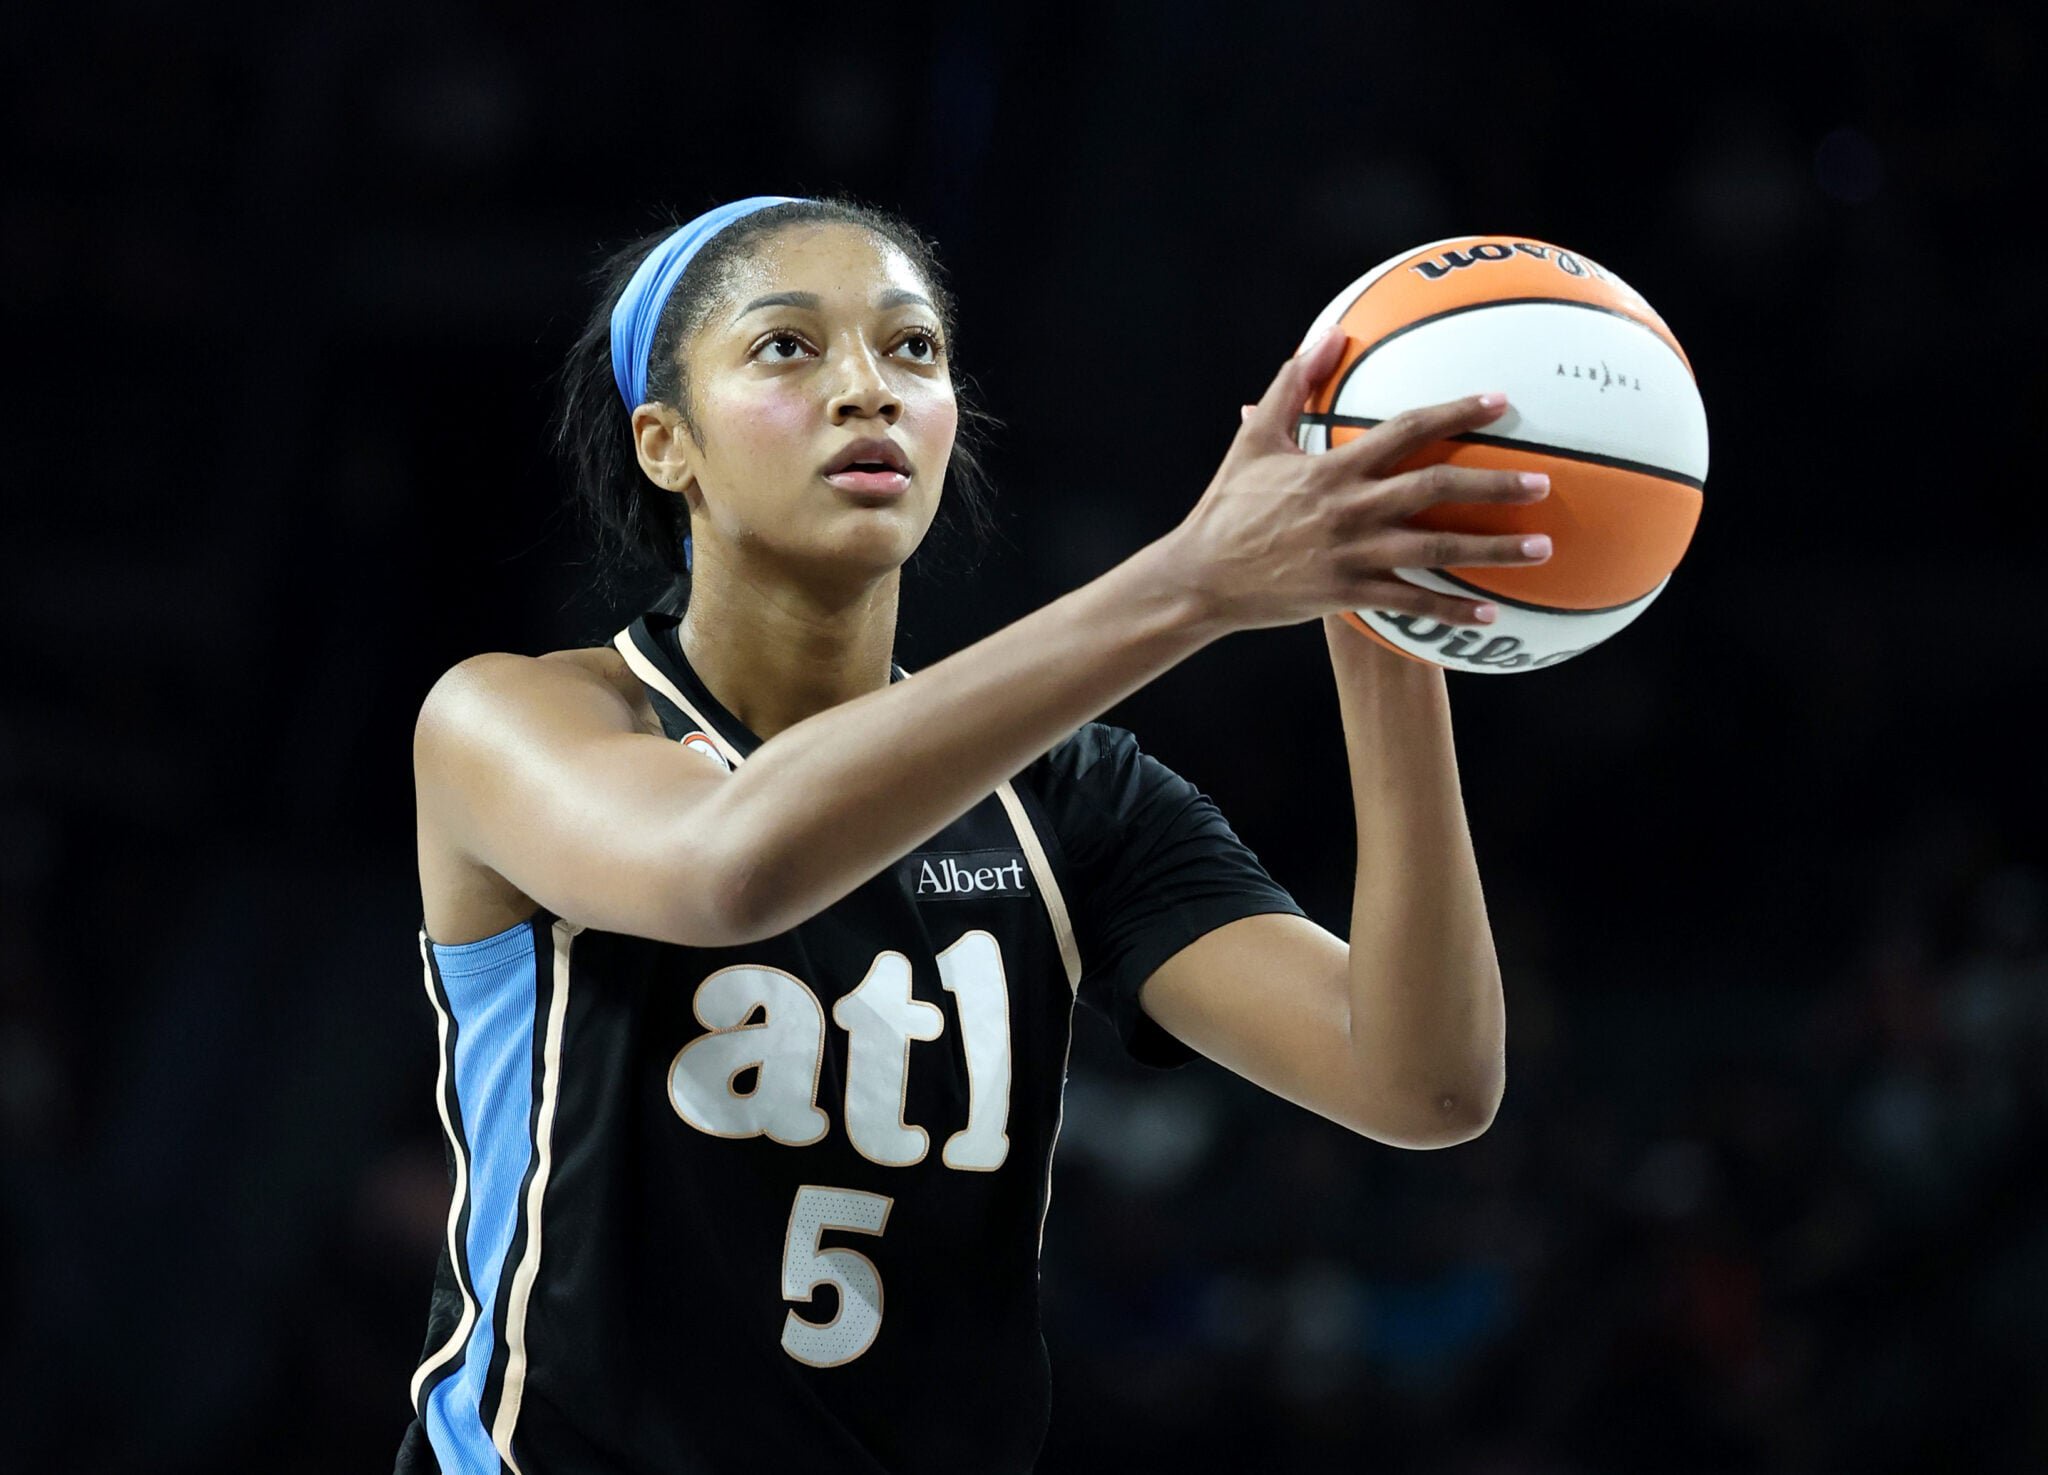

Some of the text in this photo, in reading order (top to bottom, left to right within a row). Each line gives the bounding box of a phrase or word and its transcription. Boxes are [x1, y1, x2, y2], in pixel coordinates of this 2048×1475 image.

[1409, 243, 1612, 280] lson
[917, 858, 1025, 894] Albert
[668, 930, 1012, 1171] atl
[781, 1185, 894, 1367] 5
